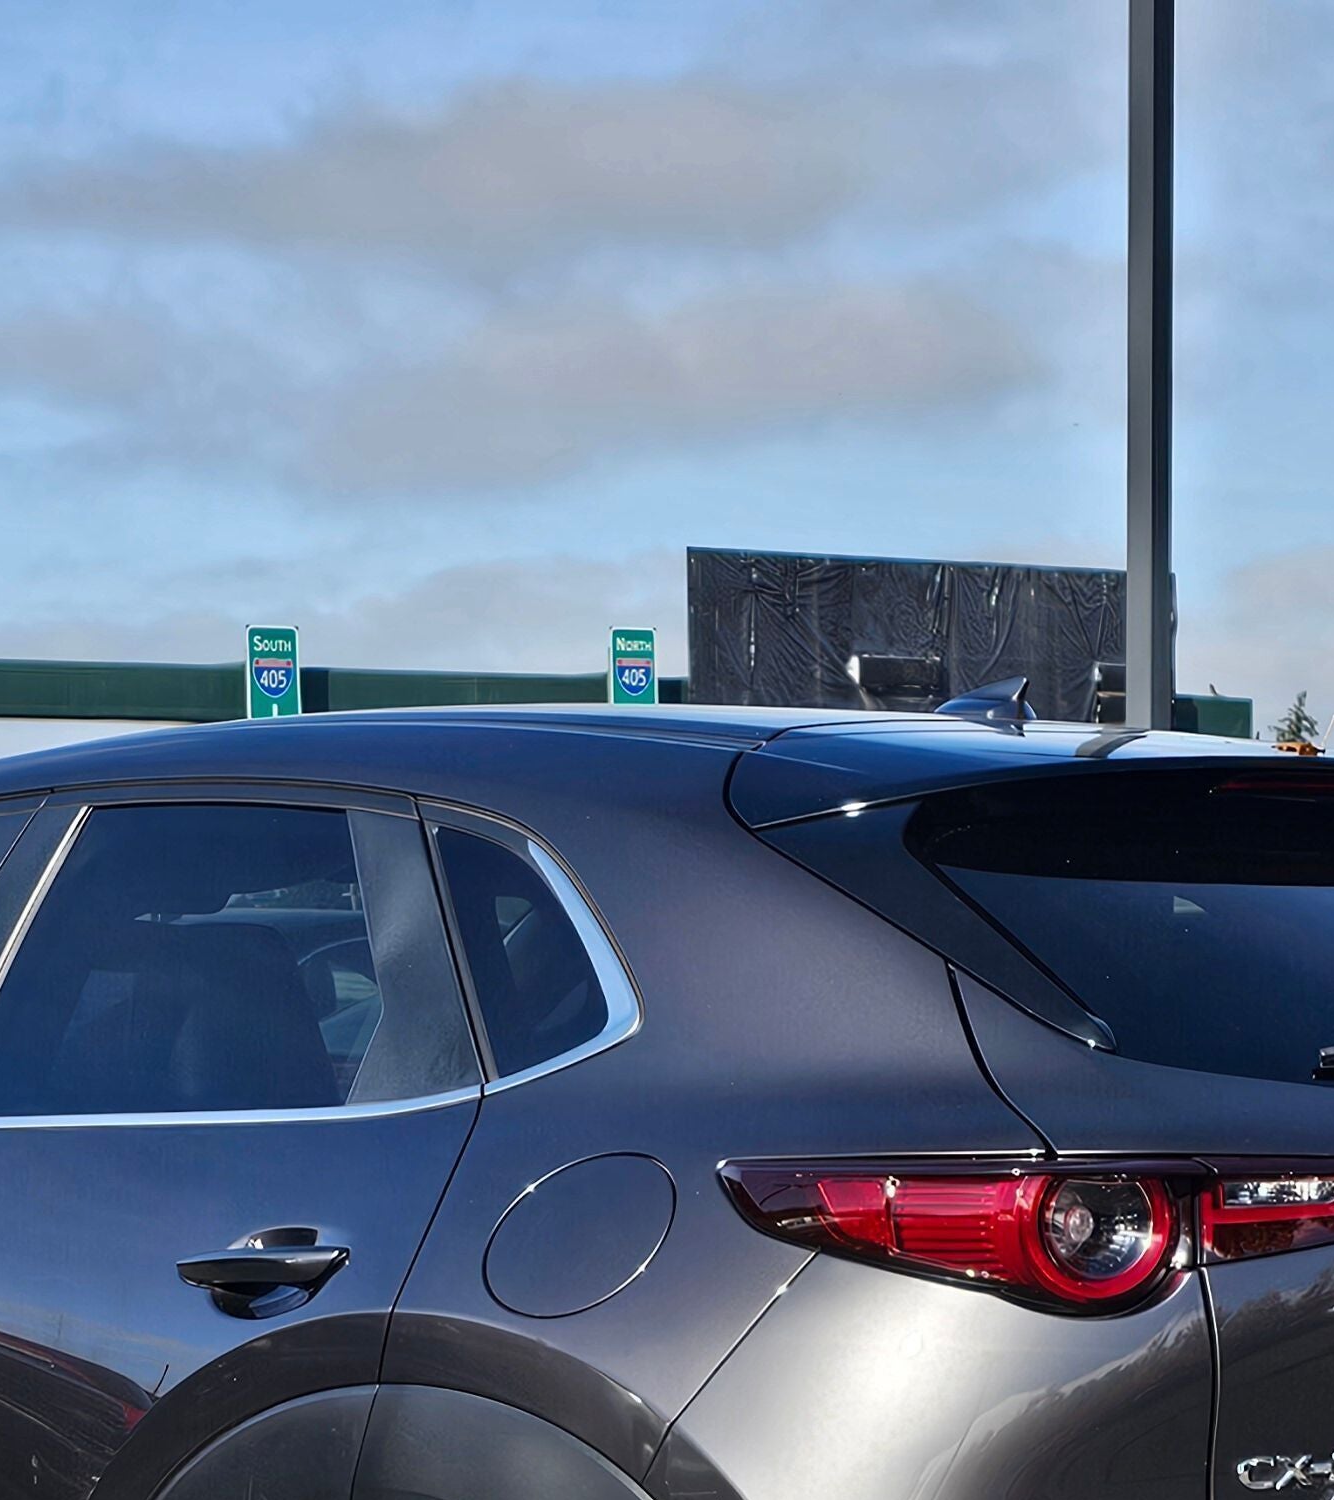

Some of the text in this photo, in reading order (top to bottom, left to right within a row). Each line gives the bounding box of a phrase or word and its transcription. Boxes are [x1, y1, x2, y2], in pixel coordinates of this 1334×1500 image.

[253, 635, 292, 652] SOUTH
[260, 669, 287, 688] 405
[621, 668, 647, 686] 405
